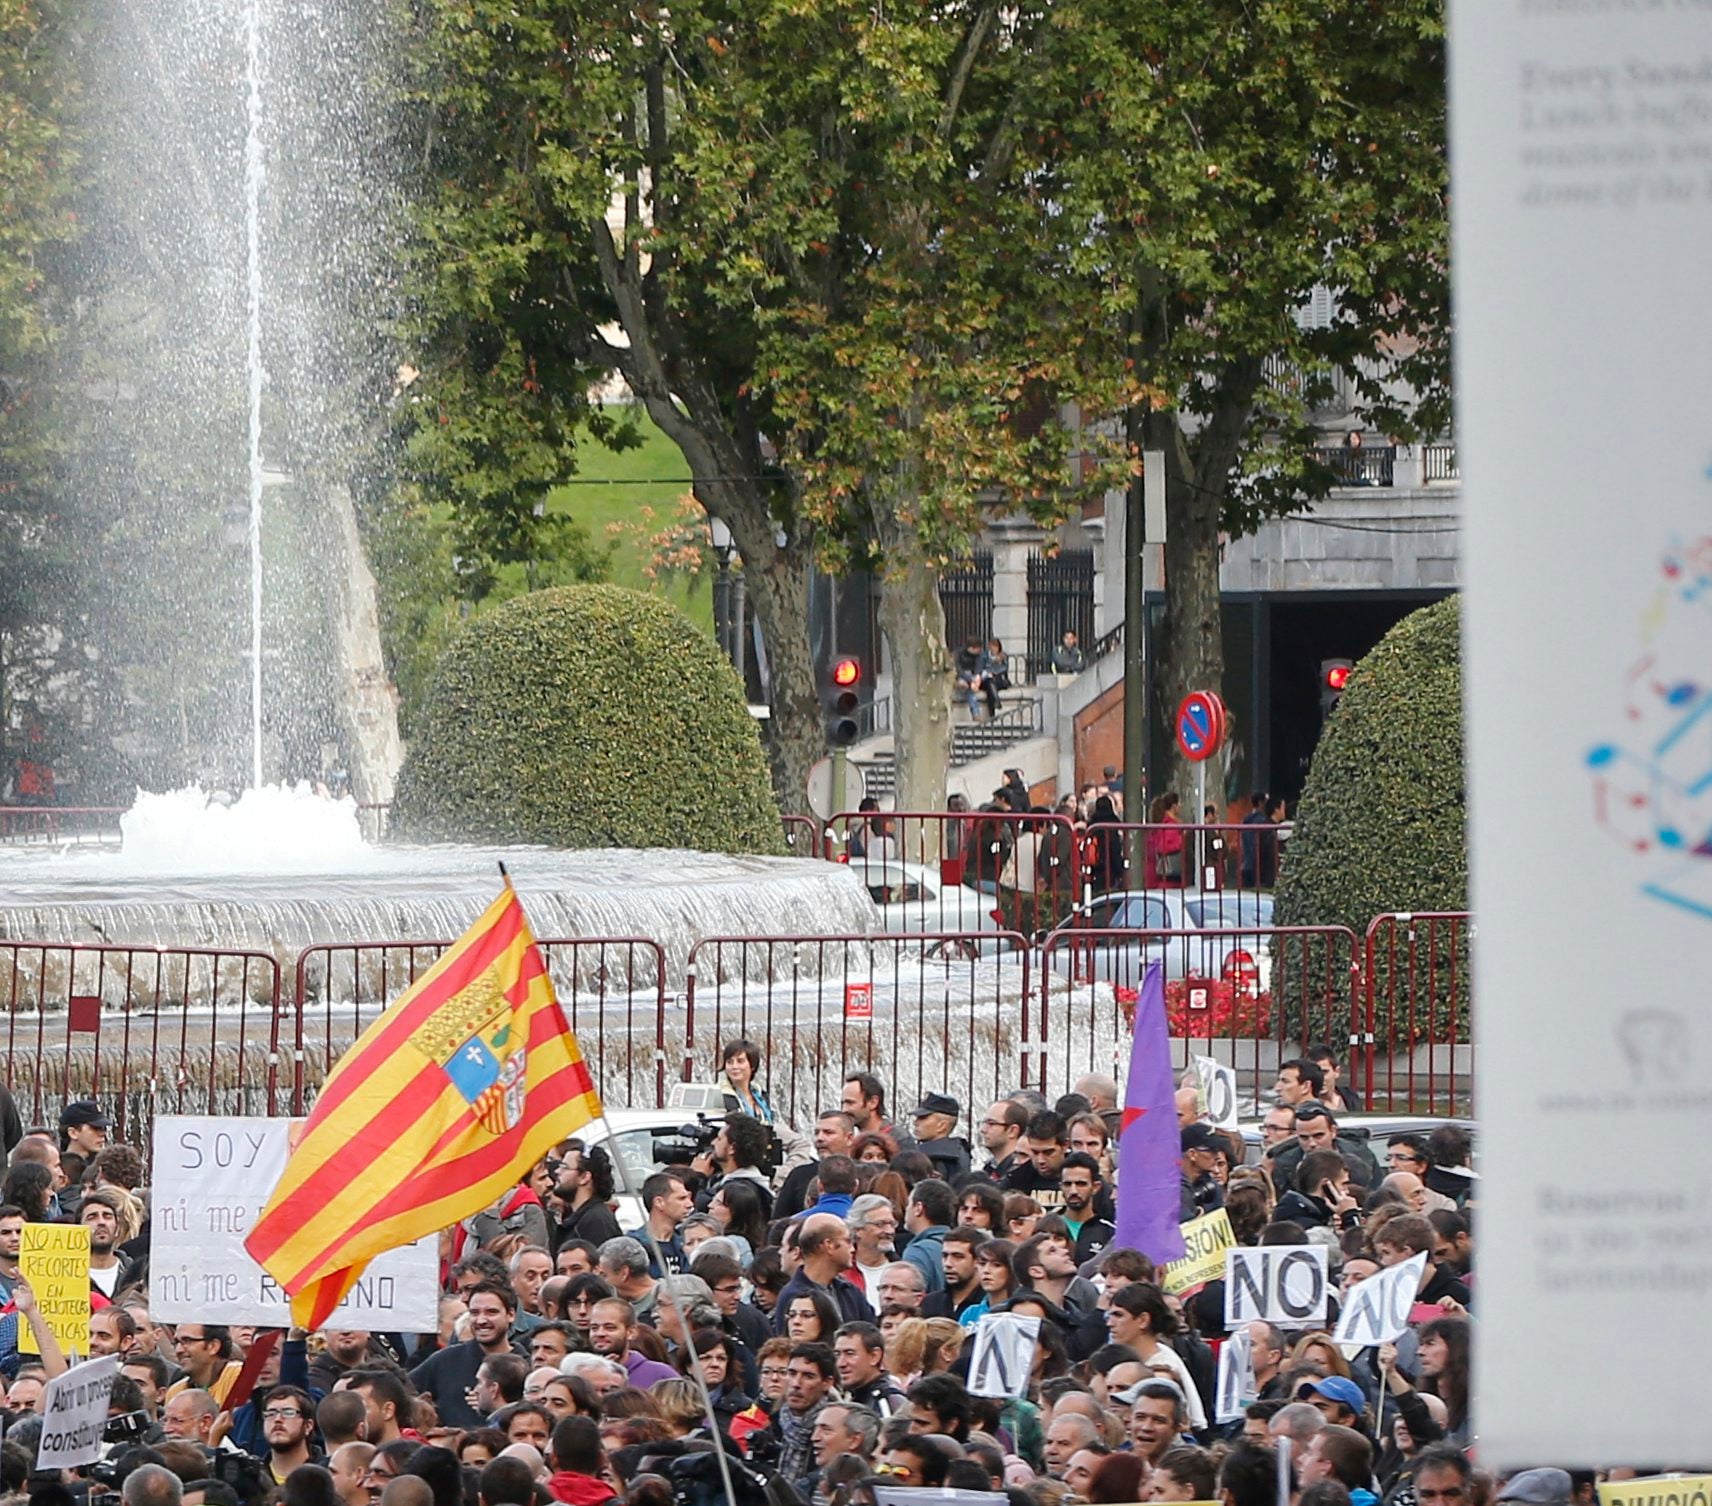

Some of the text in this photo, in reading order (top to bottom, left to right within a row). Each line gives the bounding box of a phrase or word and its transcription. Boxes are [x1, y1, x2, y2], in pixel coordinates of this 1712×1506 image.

[180, 1132, 266, 1169] SOY
[159, 1198, 246, 1233] ni me
[23, 1229, 89, 1250] NO A LOS
[26, 1255, 89, 1279] RECORTES
[46, 1283, 65, 1298] EN
[159, 1265, 192, 1302] ni
[202, 1273, 239, 1303] me
[1232, 1251, 1323, 1319] NO
[35, 1299, 89, 1317] IBLIOTECAS
[26, 1319, 87, 1341] PBLICAS
[49, 1384, 75, 1414] Abrir
